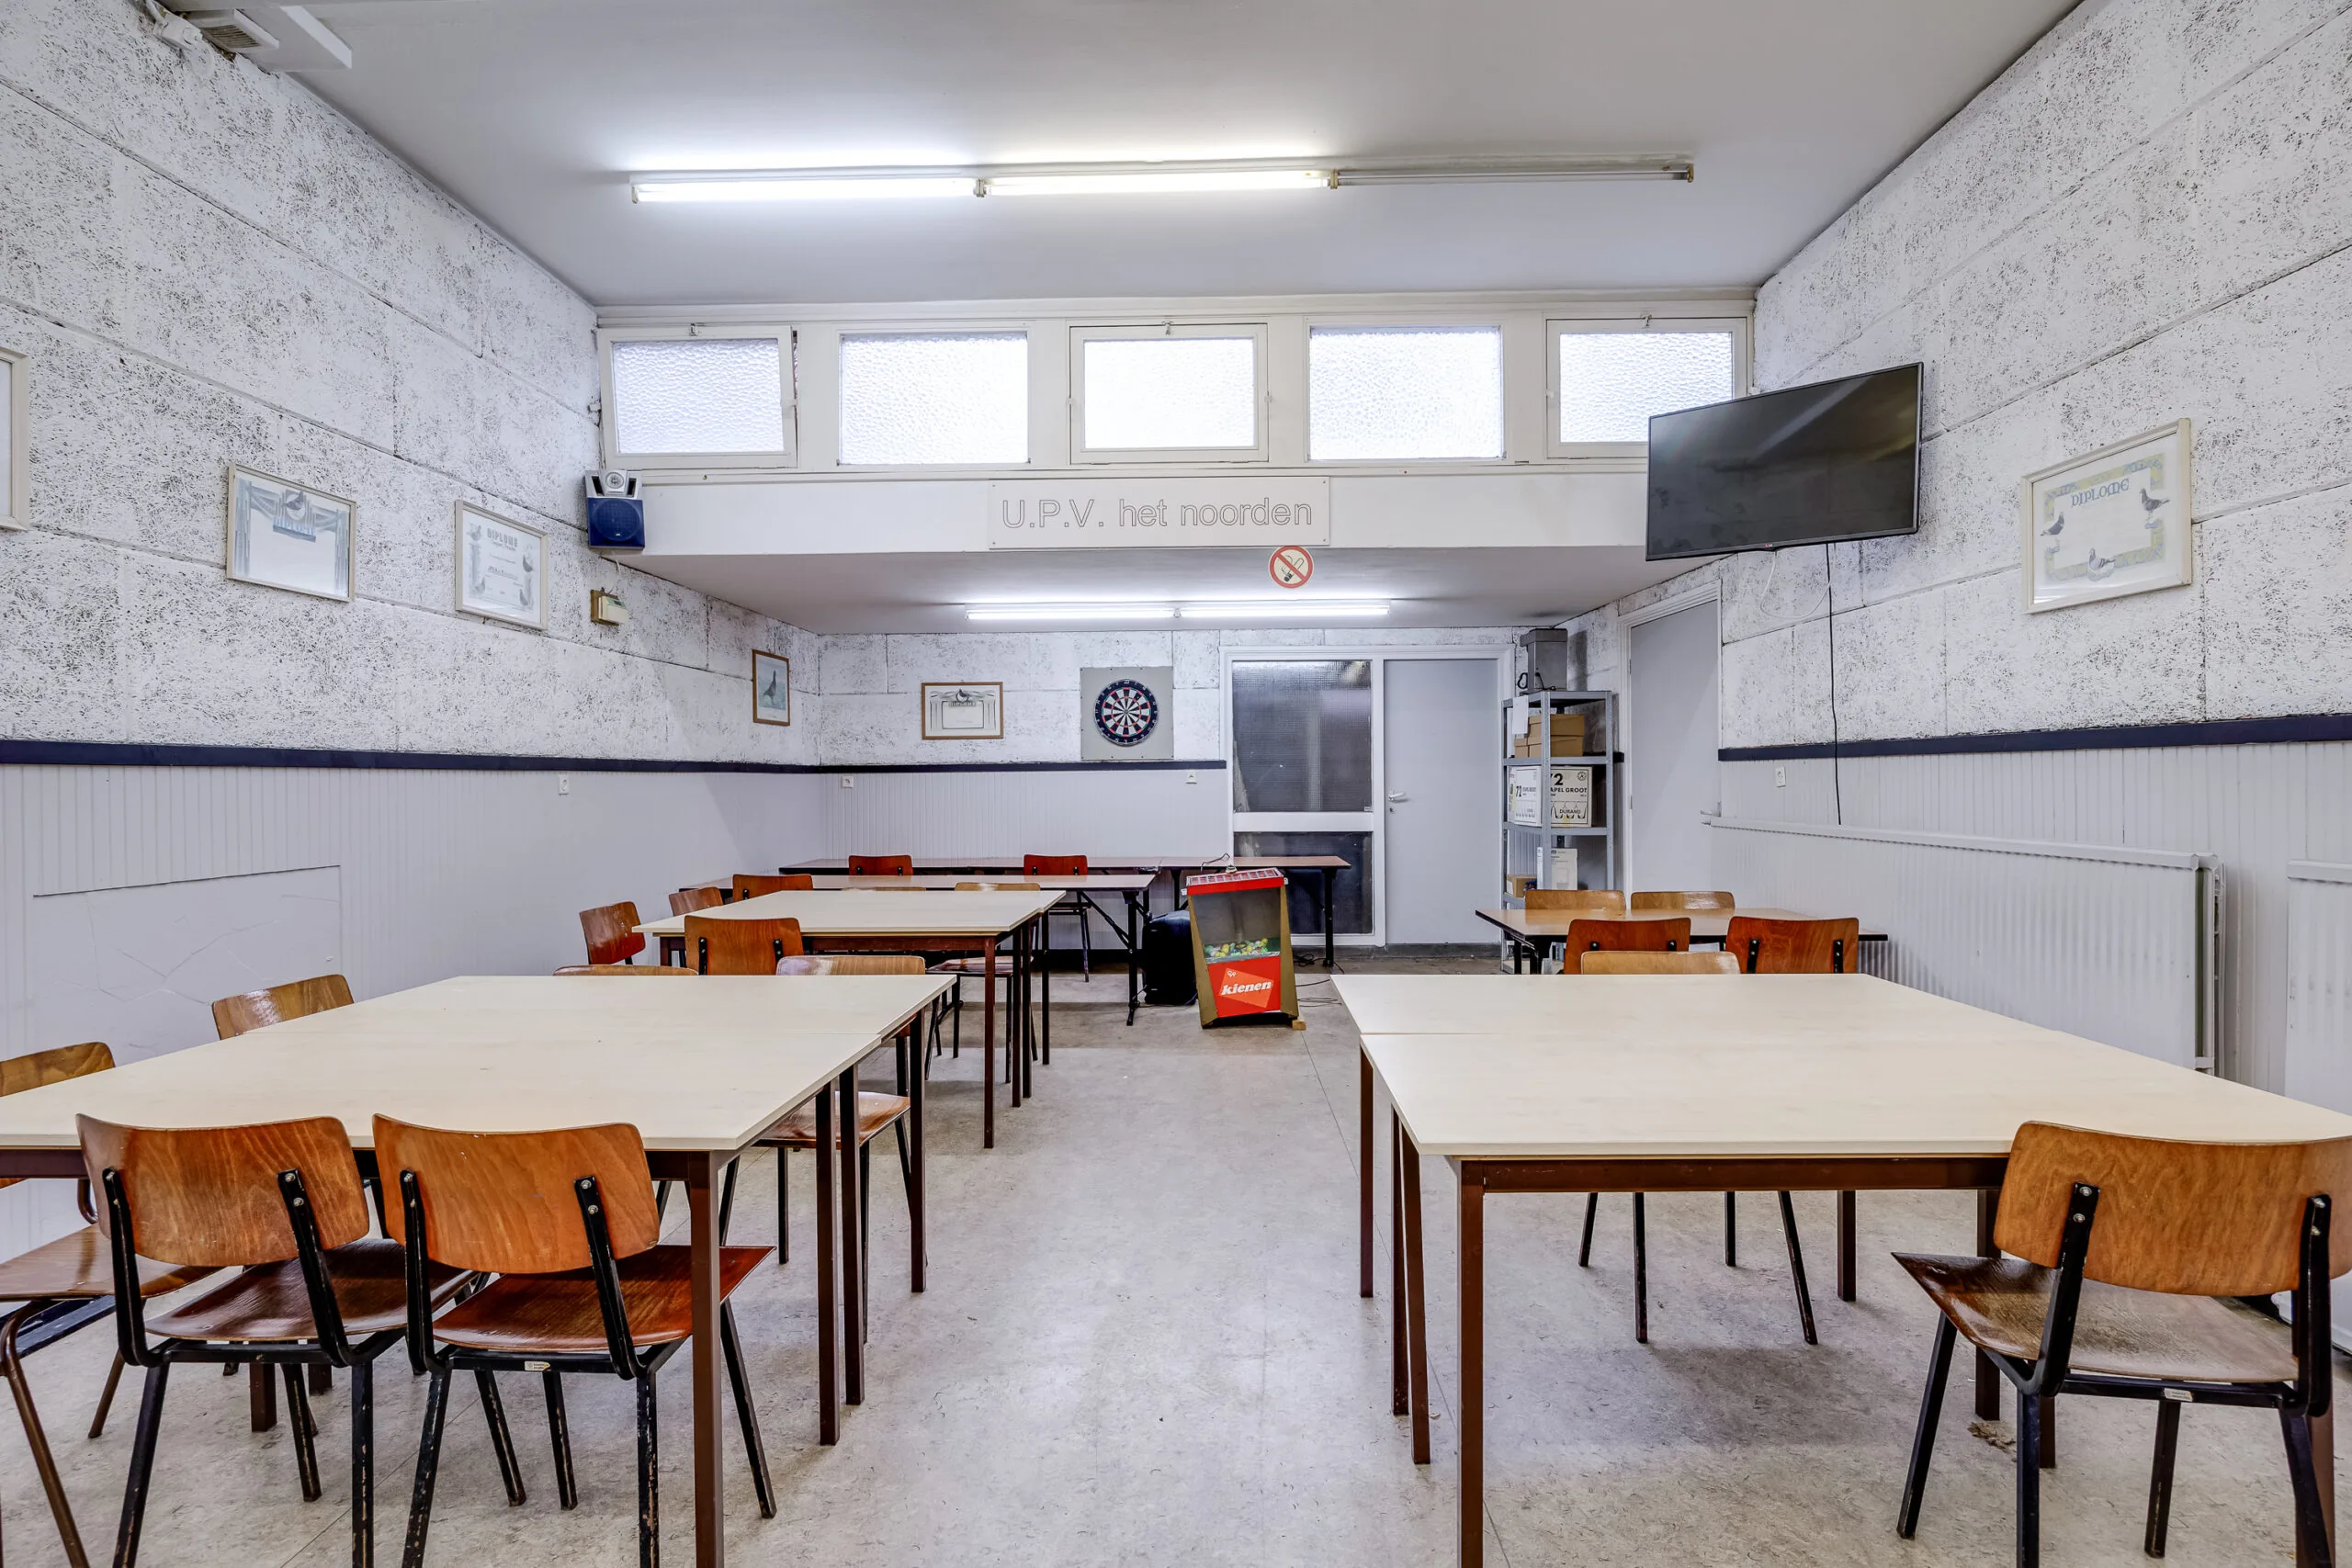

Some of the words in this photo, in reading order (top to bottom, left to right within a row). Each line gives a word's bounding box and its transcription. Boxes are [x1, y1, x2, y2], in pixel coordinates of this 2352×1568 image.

[1001, 499, 1104, 528] U.P.V.
[1118, 498, 1168, 527] het
[1180, 497, 1313, 526] noorden
[1221, 981, 1272, 996] kienen
